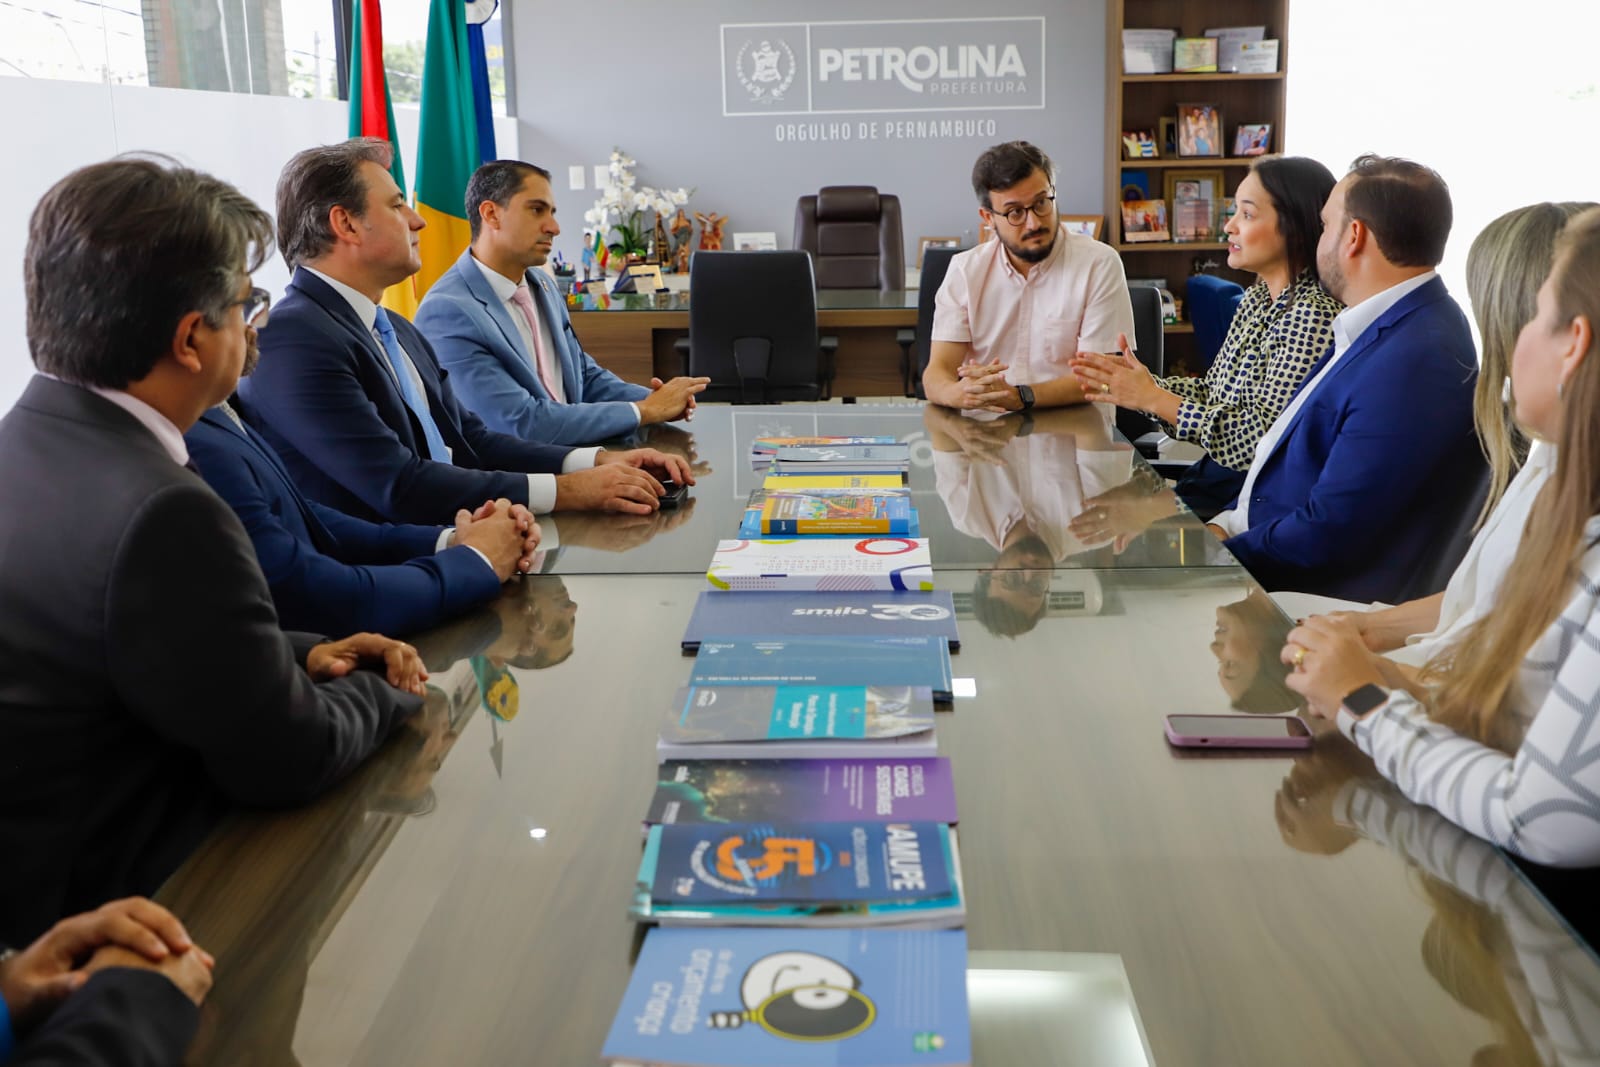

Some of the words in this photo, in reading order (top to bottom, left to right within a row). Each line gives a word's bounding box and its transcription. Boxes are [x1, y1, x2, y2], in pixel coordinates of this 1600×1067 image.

[819, 44, 1027, 93] PETROLINA
[930, 81, 1027, 95] PREFEITURA
[776, 123, 851, 142] ORGULHO
[859, 122, 879, 140] DE
[886, 119, 997, 139] PERNAMBUCO
[792, 606, 868, 616] smile
[886, 828, 927, 891] AMUPE
[670, 948, 713, 1034] orçamento
